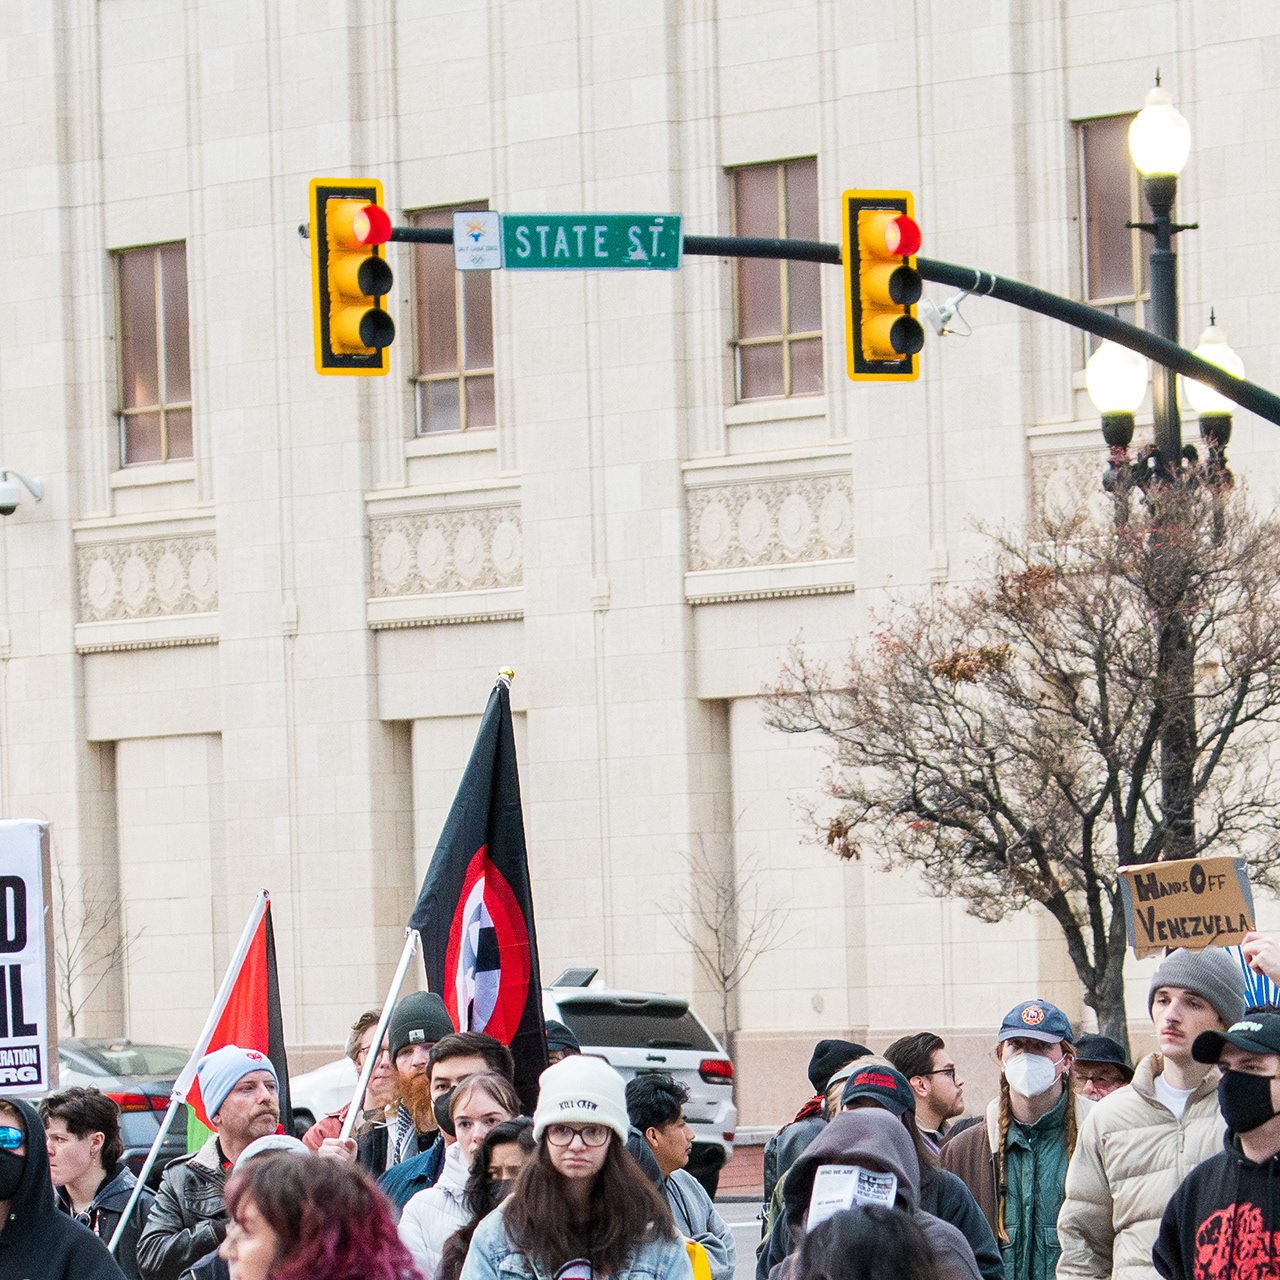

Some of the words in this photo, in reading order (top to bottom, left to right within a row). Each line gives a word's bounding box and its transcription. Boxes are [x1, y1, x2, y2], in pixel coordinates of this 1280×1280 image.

[516, 225, 609, 257] STATE
[1136, 905, 1250, 943] VENEZUELA
[559, 1100, 574, 1110] KILL
